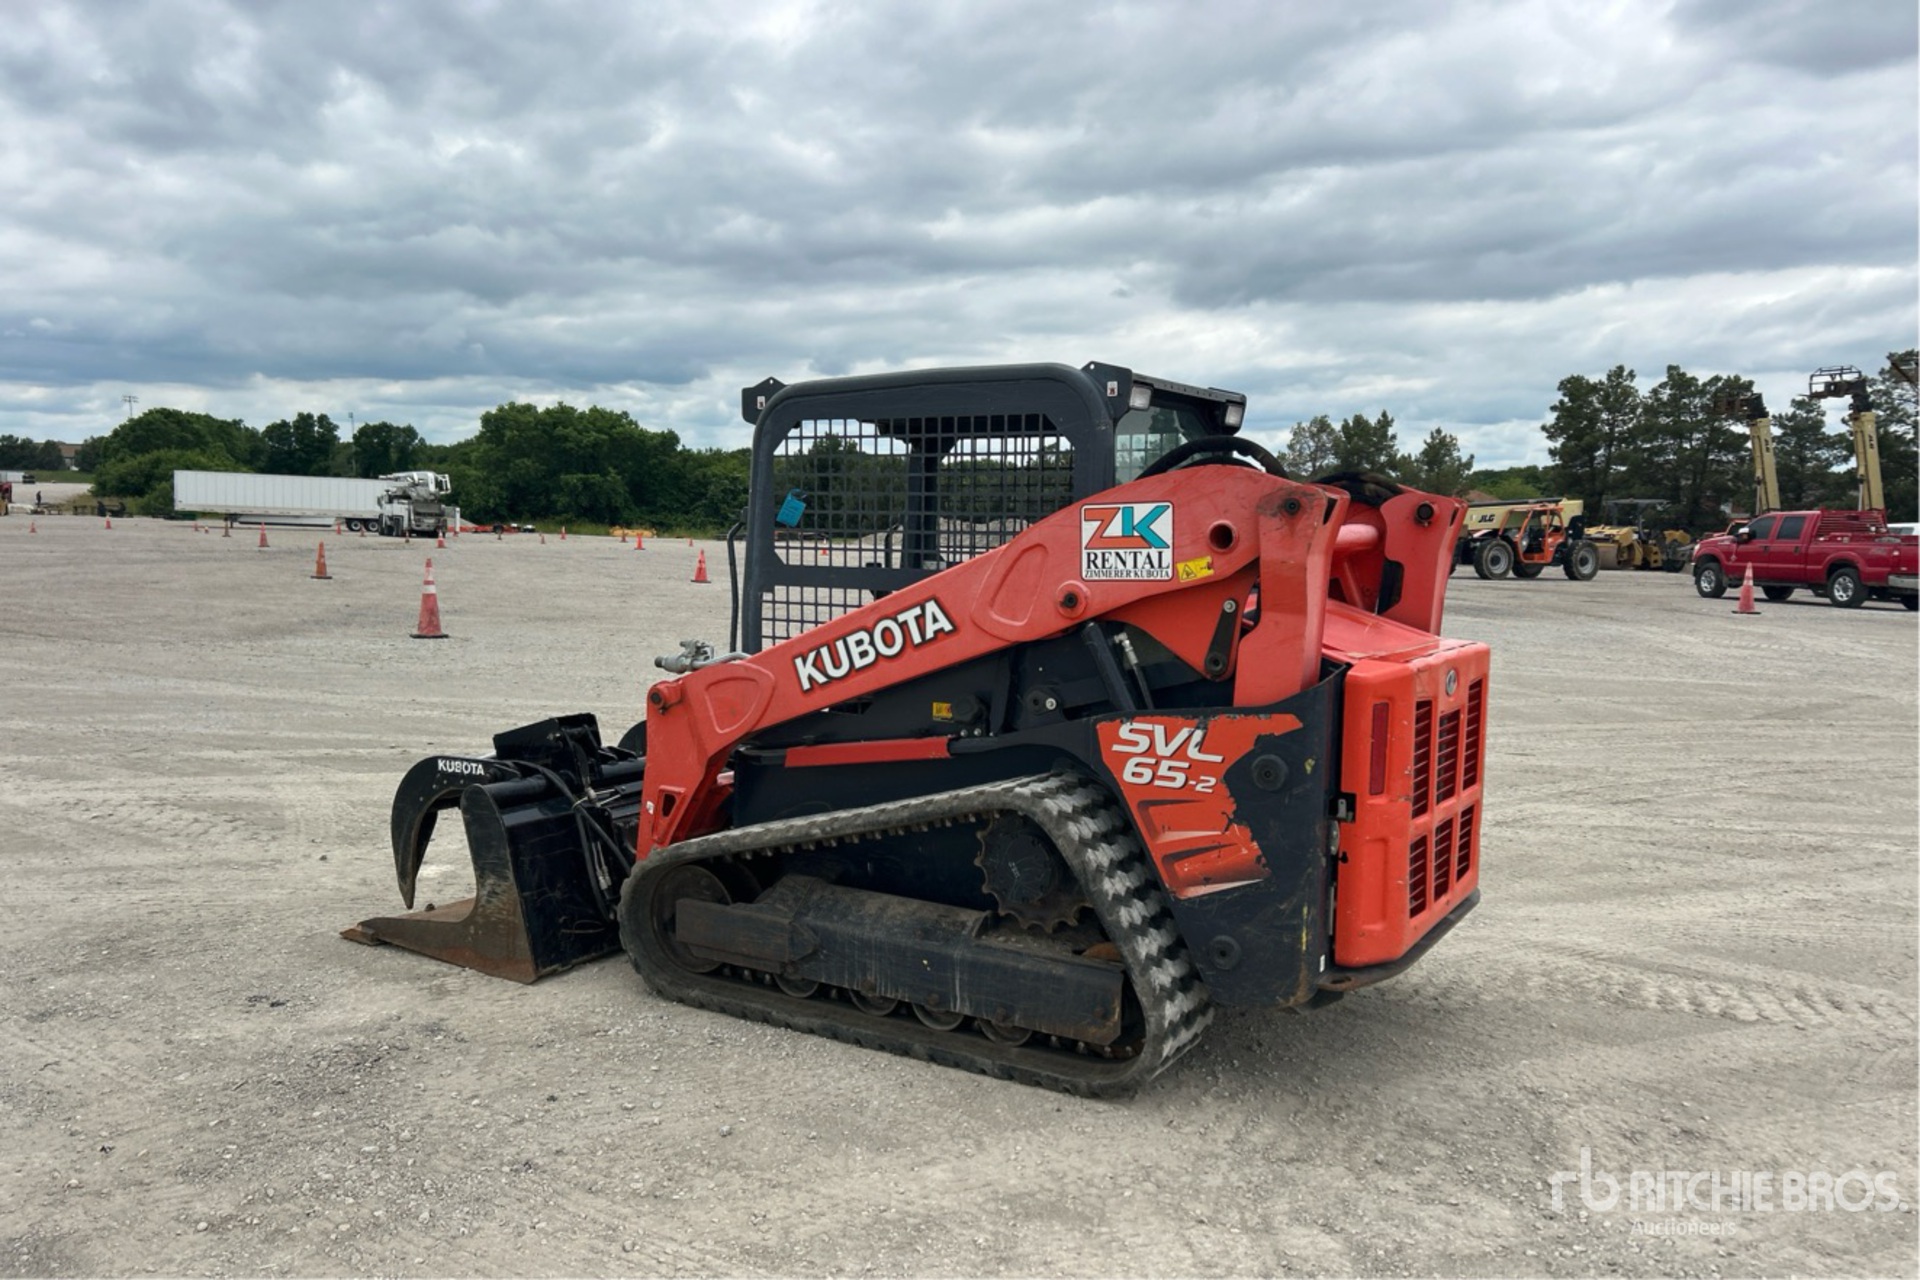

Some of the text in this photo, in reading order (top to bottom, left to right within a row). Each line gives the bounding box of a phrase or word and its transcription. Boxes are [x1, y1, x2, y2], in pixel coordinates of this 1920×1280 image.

[1084, 505, 1170, 549] ZK
[1084, 569, 1170, 578] ZIMMERER KUBOTA
[1086, 551, 1170, 569] RENTAL
[794, 599, 954, 691] KUBOTA
[1111, 722, 1225, 763] SVL
[437, 758, 485, 776] KUBOTA
[1122, 756, 1217, 793] 65-2
